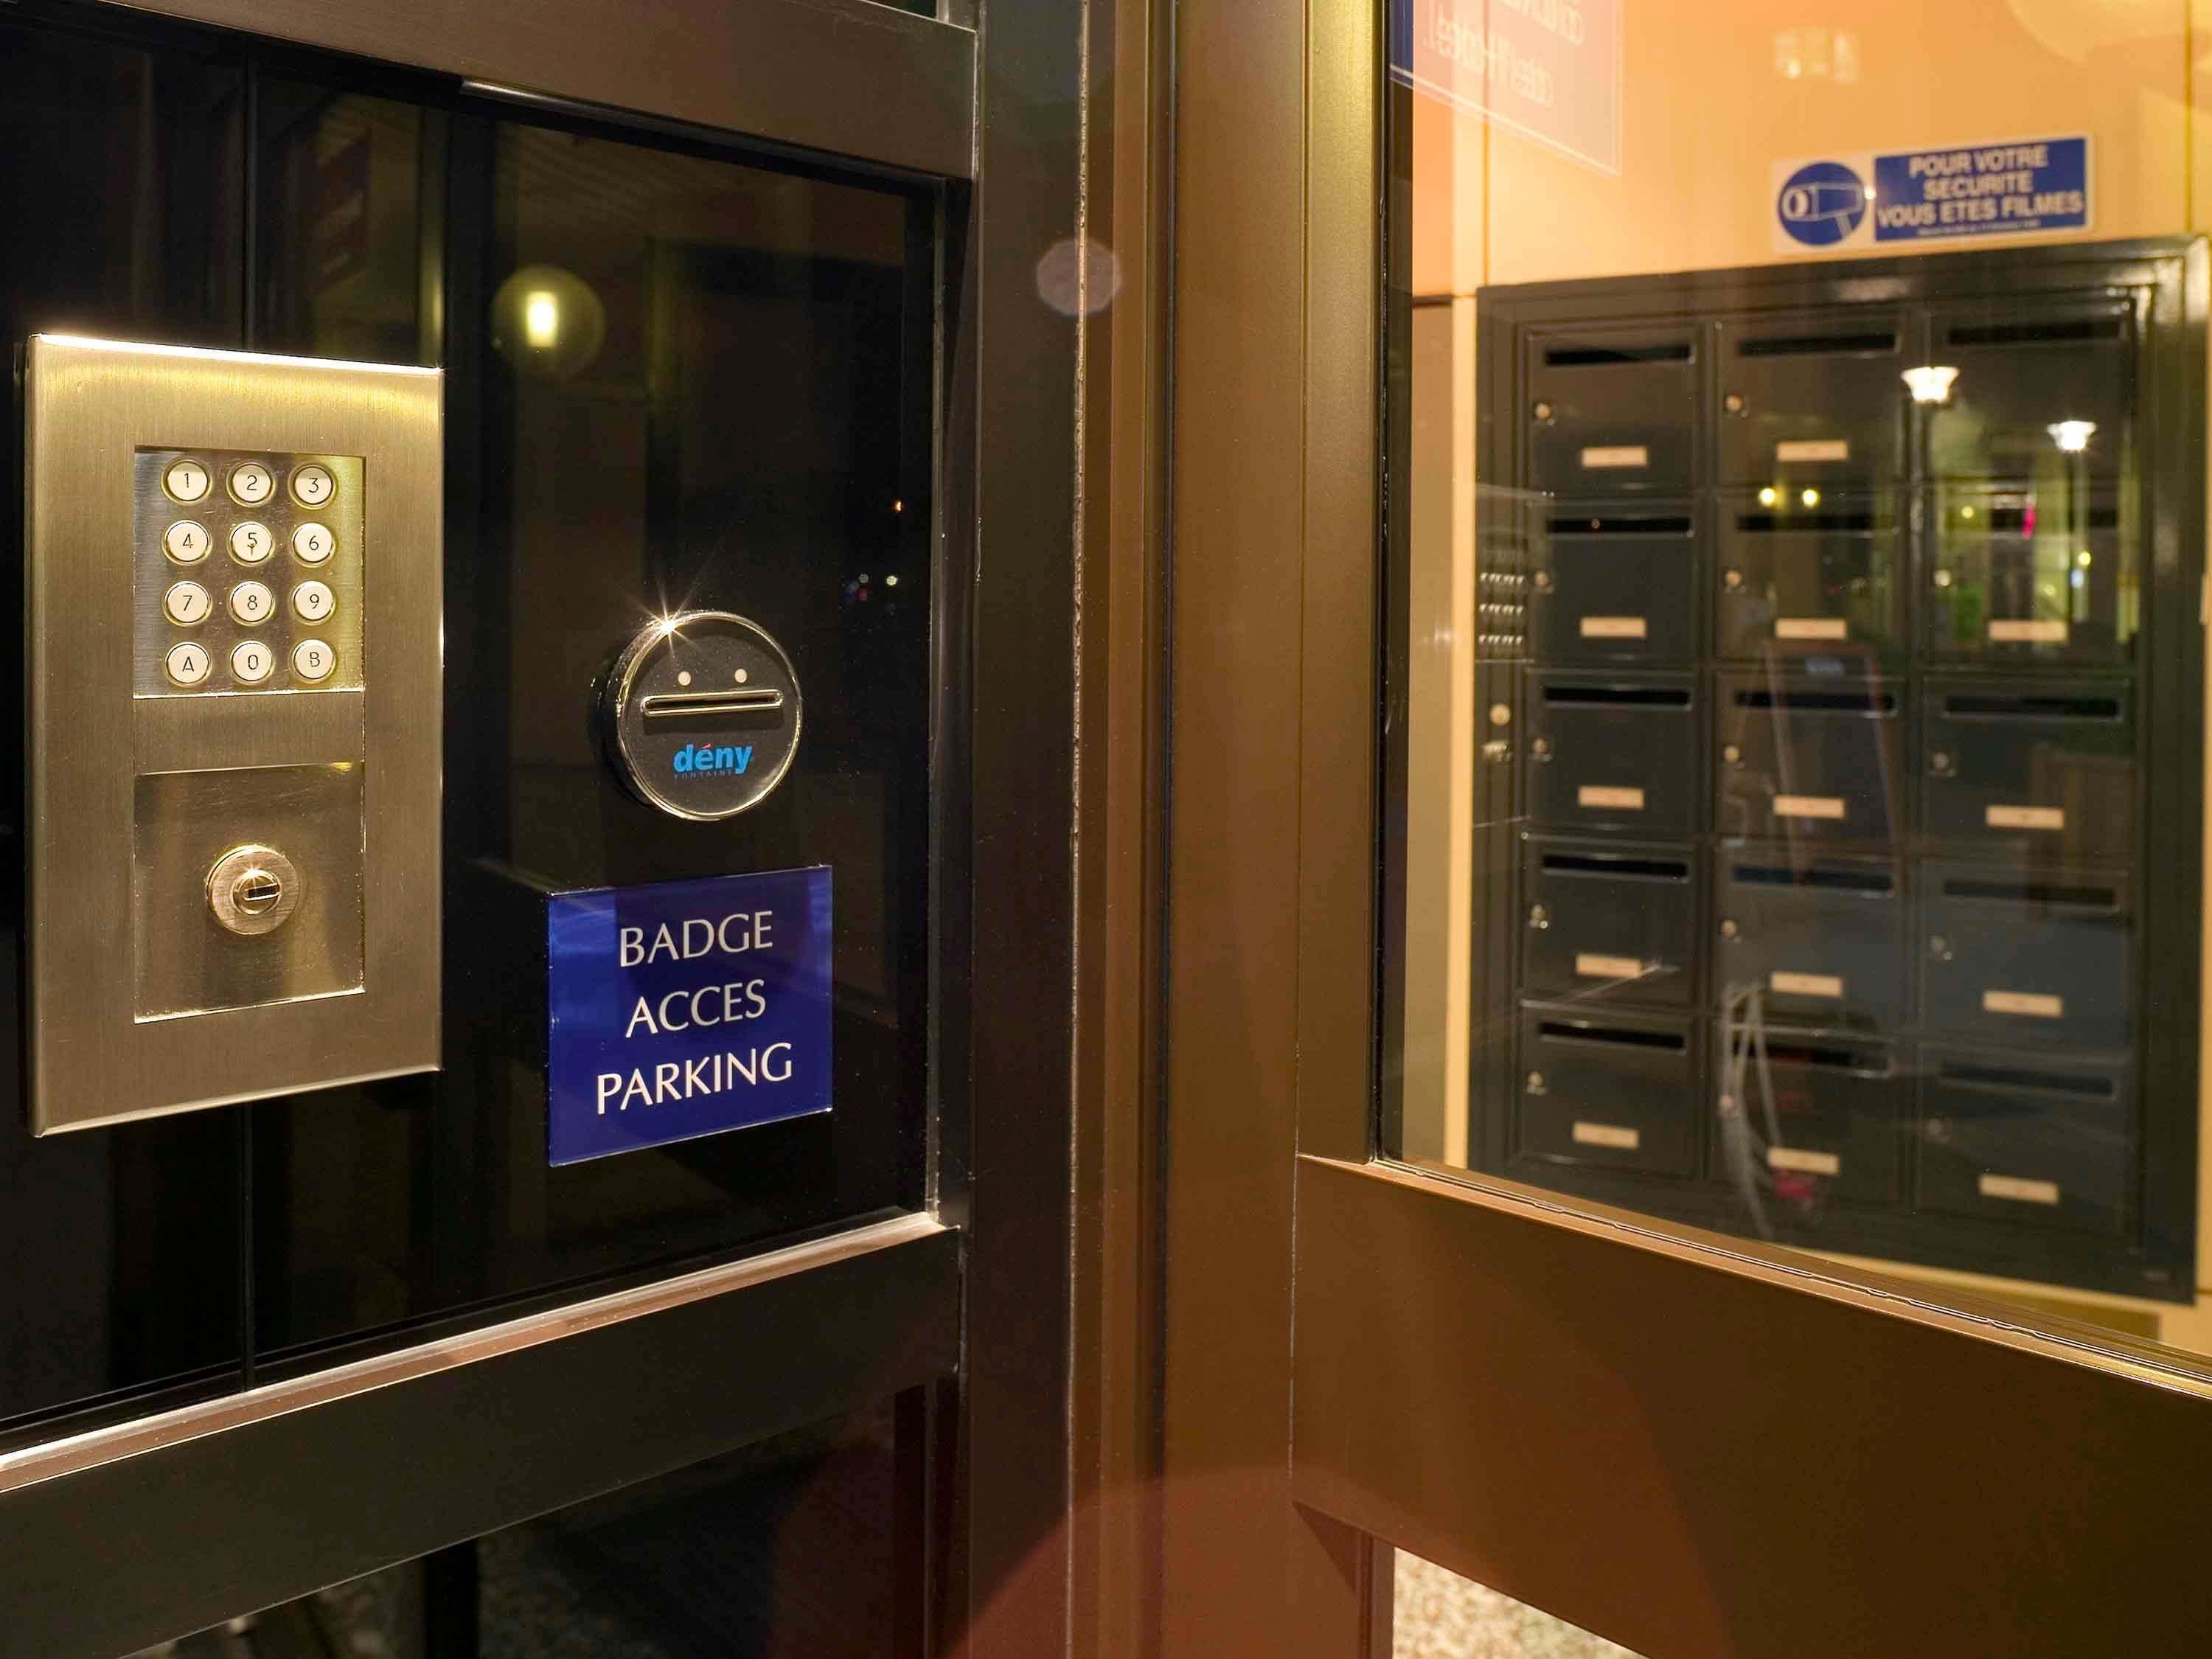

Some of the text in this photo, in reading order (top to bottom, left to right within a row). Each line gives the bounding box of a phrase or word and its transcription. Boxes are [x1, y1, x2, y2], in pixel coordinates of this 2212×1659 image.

[1909, 144, 2049, 178] POUR VOTRE
[1922, 170, 2034, 201] SECURITE
[1876, 204, 1936, 228] VOUS
[1939, 198, 1997, 224] ETES
[2001, 191, 2084, 218] FILMES
[246, 474, 258, 491] 2
[308, 477, 319, 493] 3
[182, 532, 319, 551] 4 5 6
[182, 594, 320, 611] 7 8 9
[182, 655, 195, 672] A
[309, 651, 321, 667] B
[673, 742, 753, 774] dény
[620, 910, 773, 967] BADGE
[625, 979, 766, 1038] ACCES
[597, 1042, 793, 1115] PARKING
